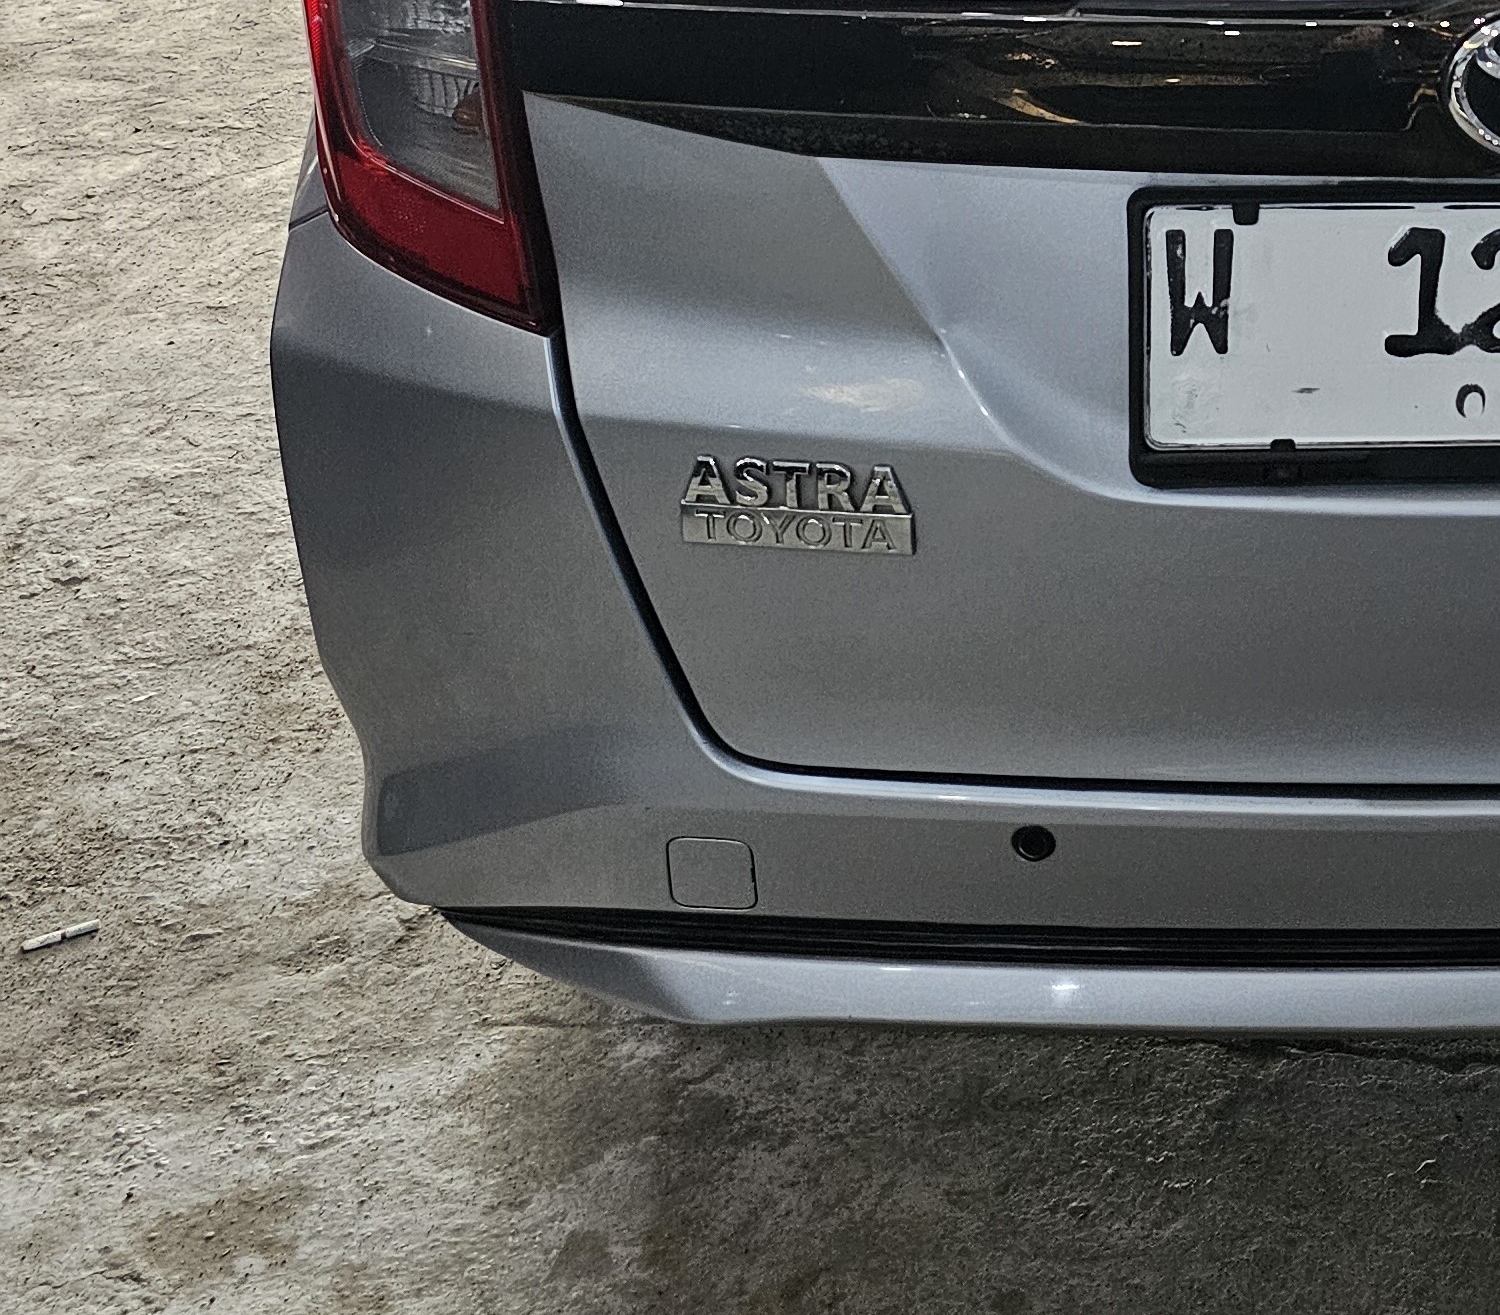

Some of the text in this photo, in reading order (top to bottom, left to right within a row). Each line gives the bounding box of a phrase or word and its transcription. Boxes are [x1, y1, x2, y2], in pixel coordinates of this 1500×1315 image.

[1166, 227, 1235, 357] W
[684, 455, 911, 514] ASTRA
[694, 508, 897, 552] TOYOTA
